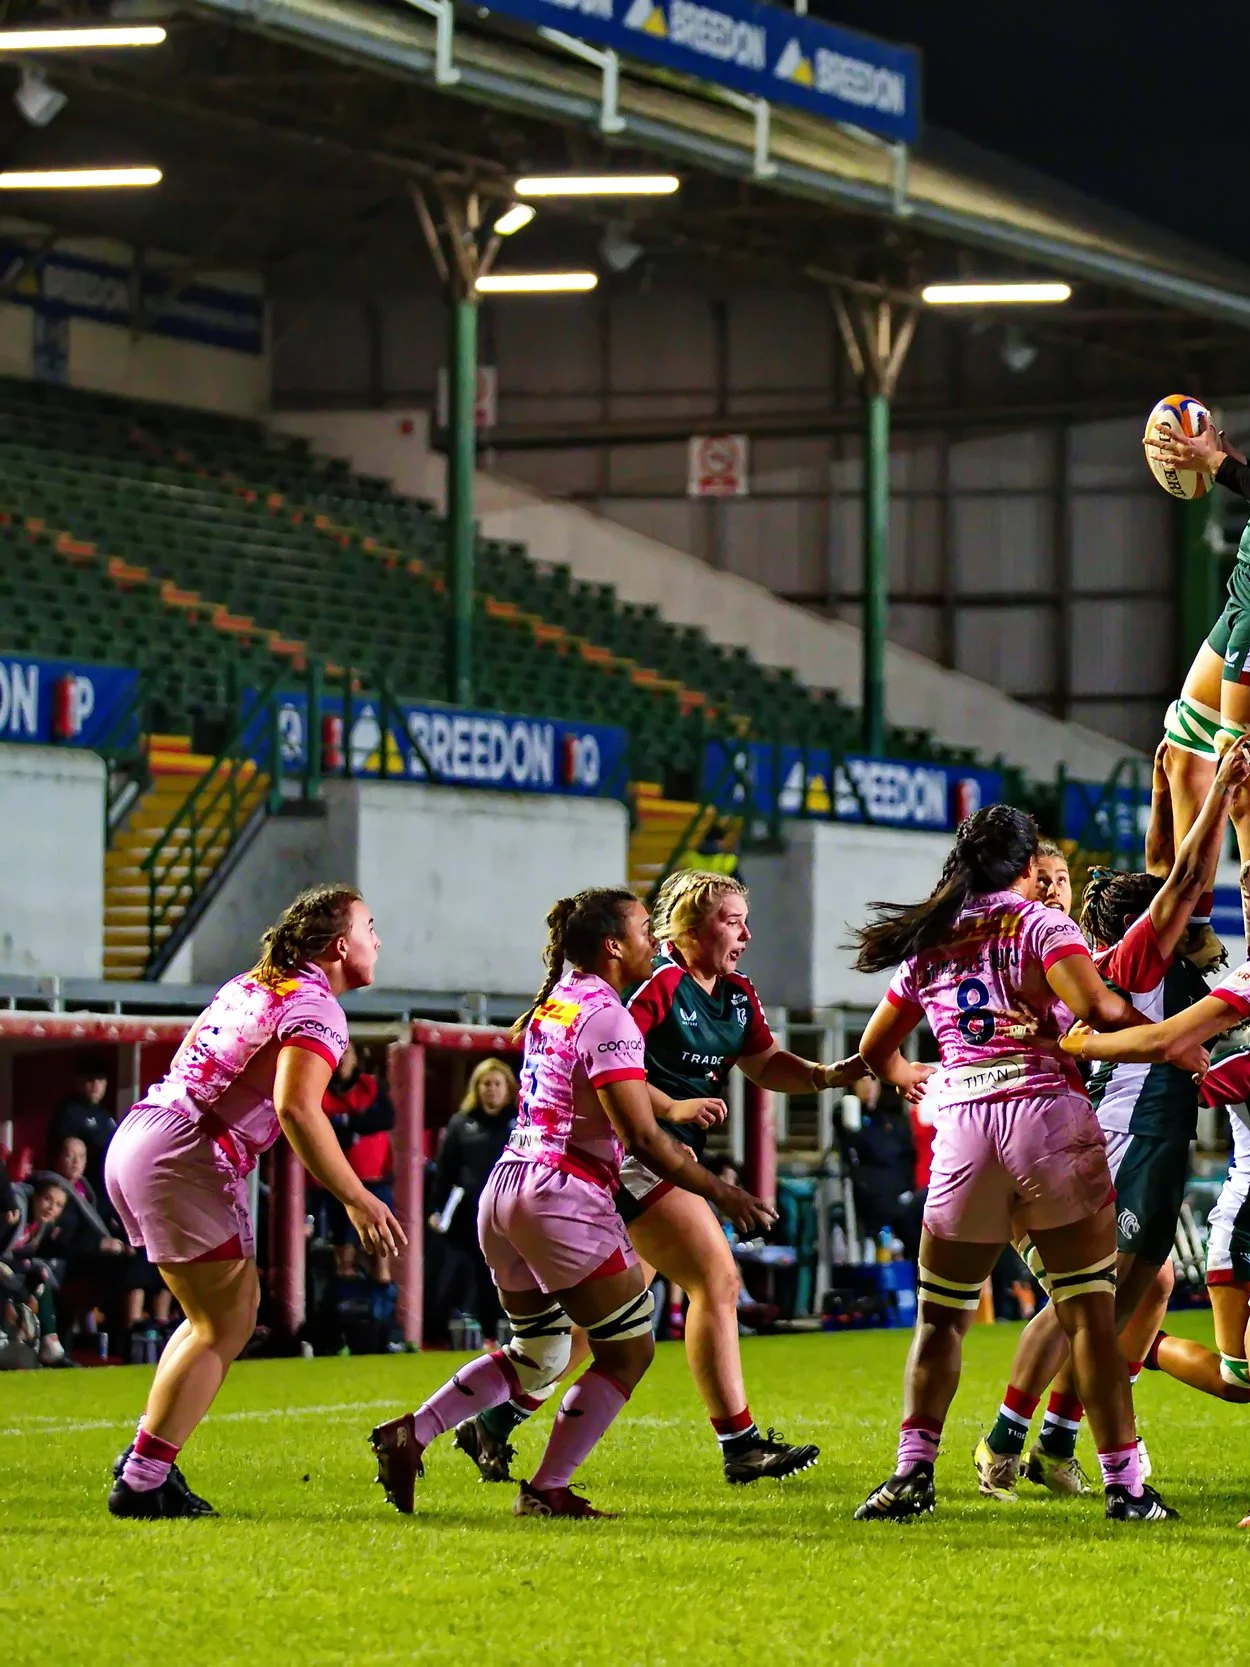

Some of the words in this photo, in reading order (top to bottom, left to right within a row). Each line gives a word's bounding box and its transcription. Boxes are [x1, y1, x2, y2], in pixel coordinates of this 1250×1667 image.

[668, 0, 766, 70] BREEDON
[815, 48, 905, 115] BREEDON
[1159, 421, 1187, 498] GIERT
[408, 711, 555, 787] BREEDON
[304, 1020, 348, 1050] conrad
[597, 1038, 643, 1053] conrad
[956, 977, 996, 1047] 8
[963, 1068, 1009, 1089] TITAN
